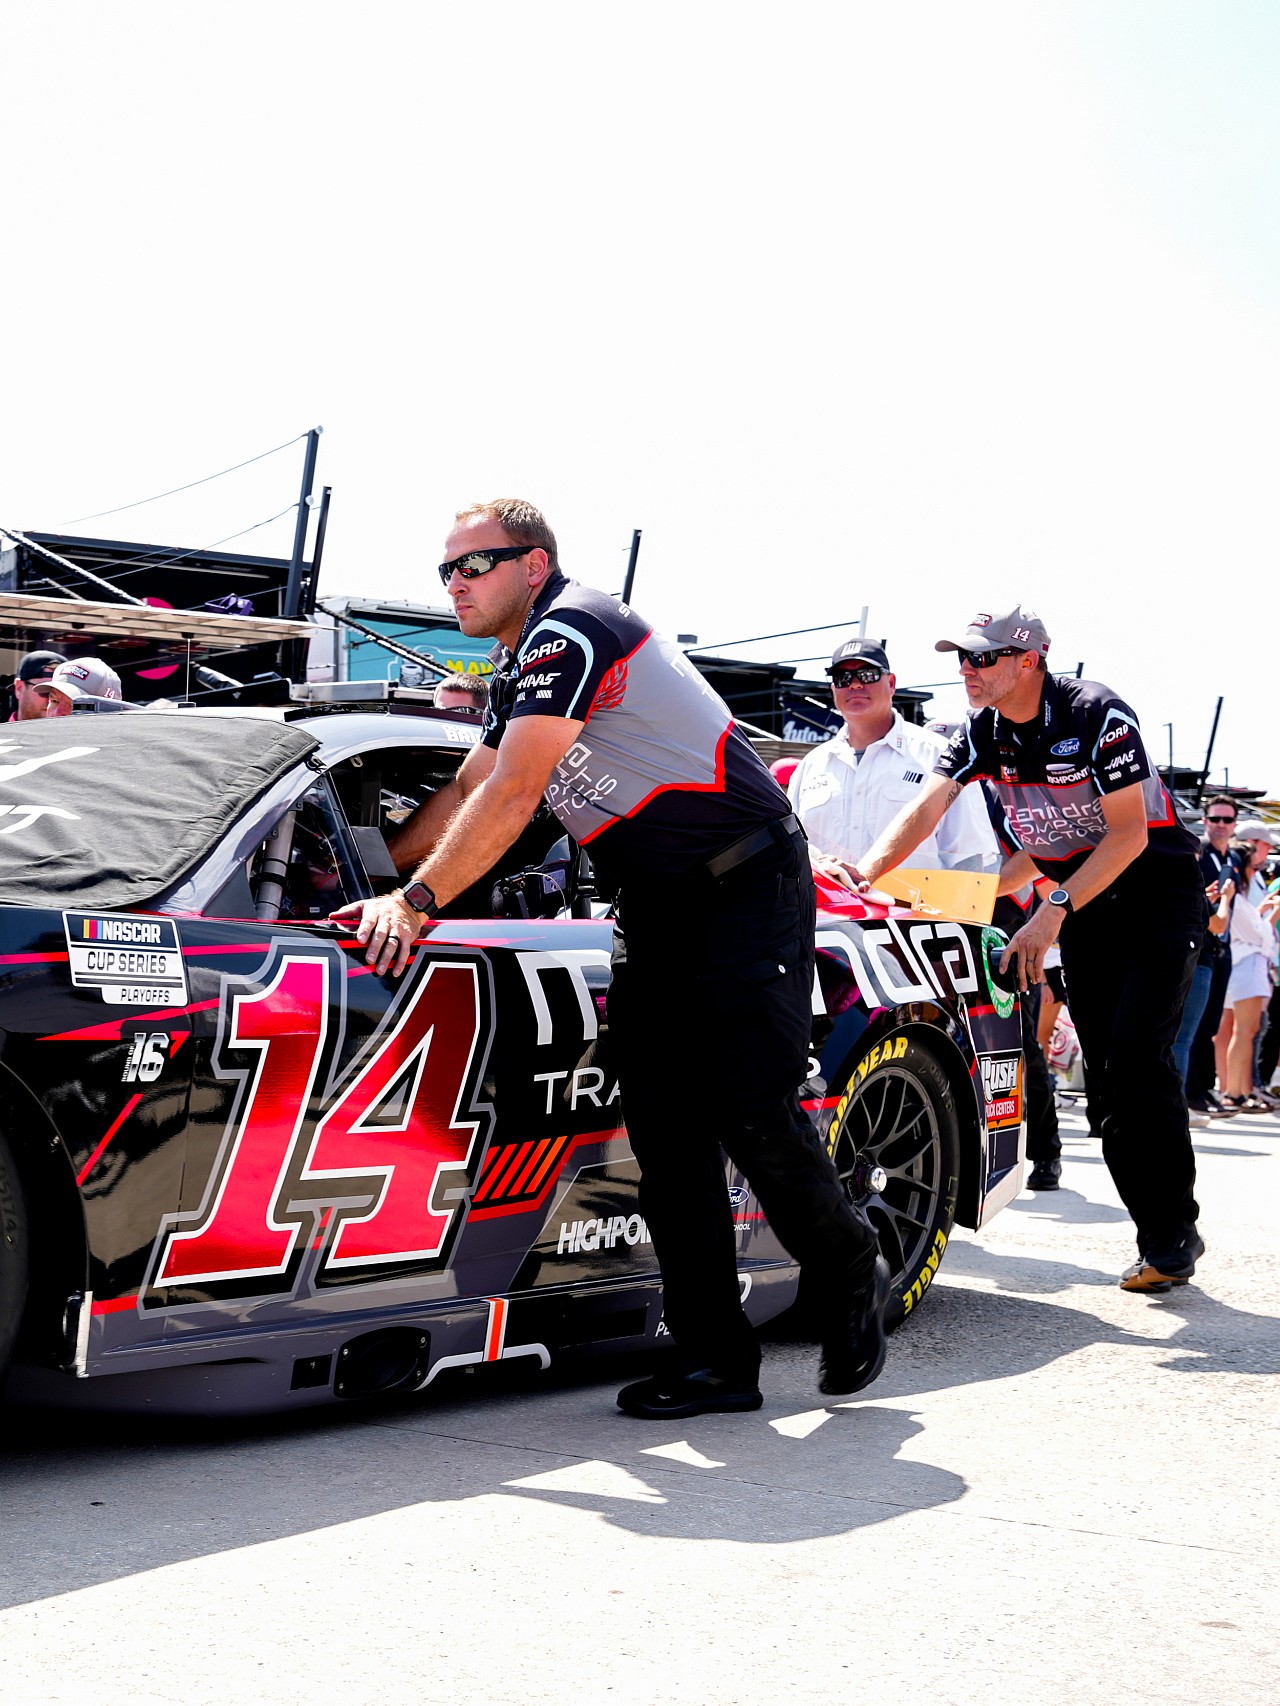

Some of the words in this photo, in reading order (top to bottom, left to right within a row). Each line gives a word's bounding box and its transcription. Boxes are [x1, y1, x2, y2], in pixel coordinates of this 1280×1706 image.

[1011, 627, 1031, 643] 14
[521, 638, 567, 672] FORD
[516, 672, 562, 690] HAAS
[1058, 741, 1080, 754] Ford
[1100, 724, 1129, 748] FORD
[1104, 749, 1136, 771] HAAS
[102, 919, 161, 944] NASCAR
[87, 951, 115, 971] CUP
[118, 953, 167, 974] SERIES
[121, 988, 170, 1003] PLAYOFFS
[126, 1032, 170, 1082] 16
[981, 1057, 1019, 1104] RUSH
[154, 956, 481, 1289] 14
[902, 1228, 948, 1315] EAGLE
